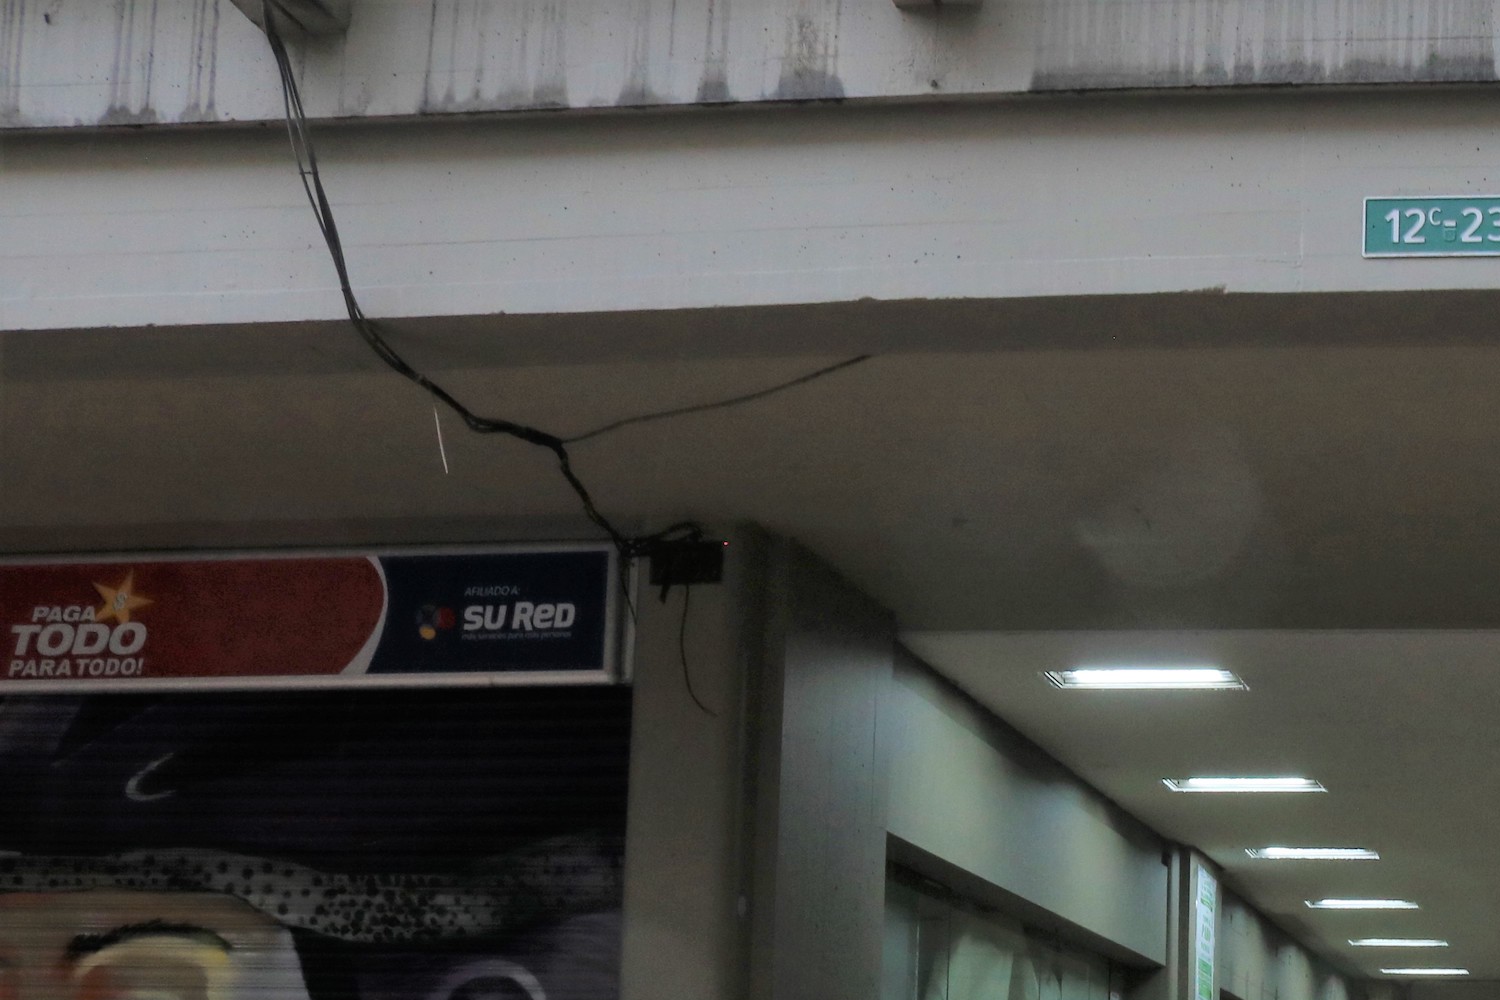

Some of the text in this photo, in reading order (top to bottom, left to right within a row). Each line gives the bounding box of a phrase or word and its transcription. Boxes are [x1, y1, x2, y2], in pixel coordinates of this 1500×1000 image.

[32, 605, 96, 623] PAGA
[463, 604, 508, 631] SU
[11, 621, 148, 657] TODO
[8, 657, 145, 678] PARA TODO!
